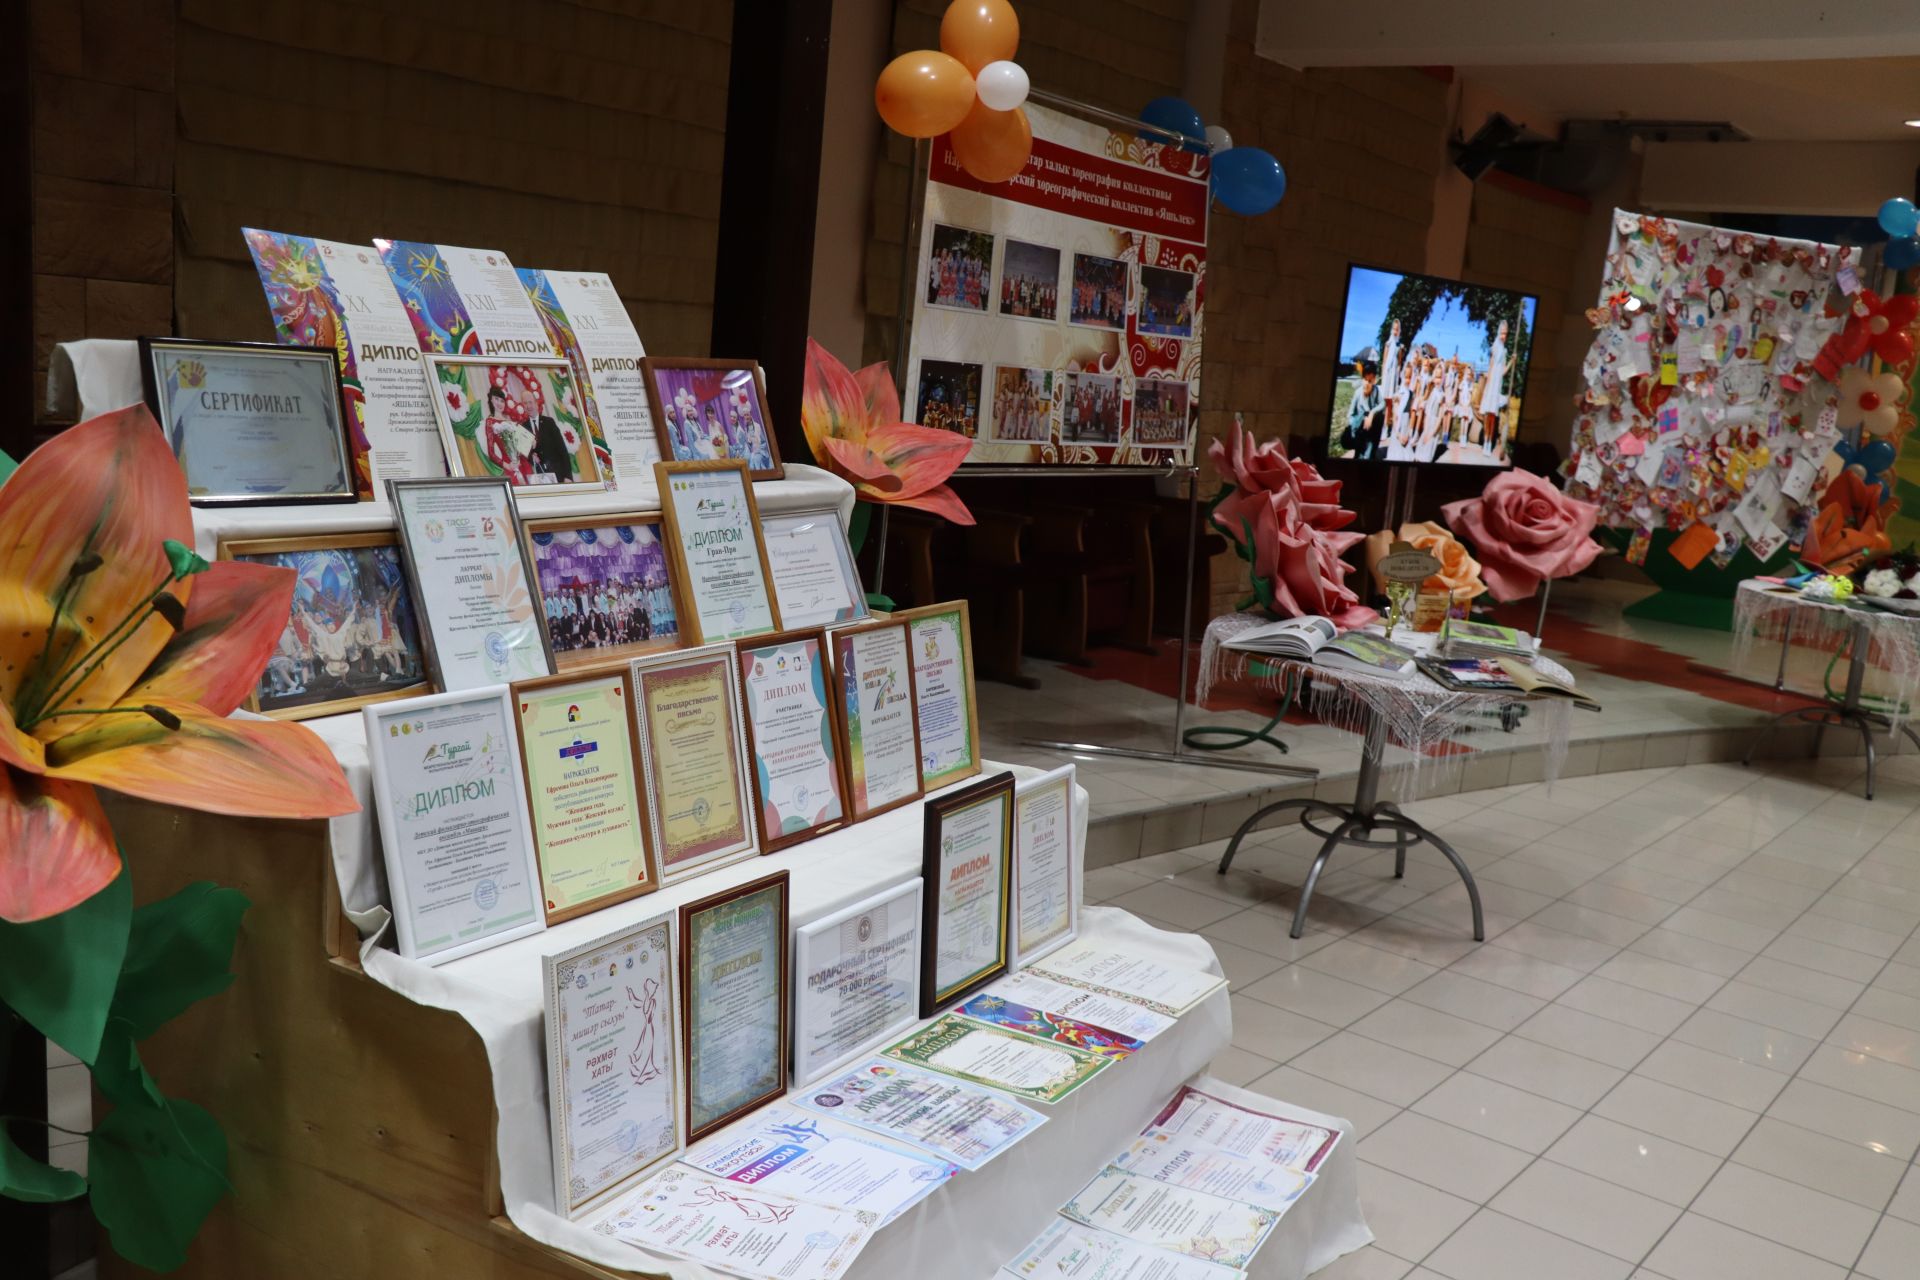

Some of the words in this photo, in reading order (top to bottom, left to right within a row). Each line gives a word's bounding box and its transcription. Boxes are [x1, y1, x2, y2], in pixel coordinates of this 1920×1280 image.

[1045, 158, 1070, 175] халык
[1072, 166, 1120, 189] хореография
[1122, 181, 1172, 200] коллективы
[1009, 173, 1036, 188] рский
[1036, 179, 1110, 206] хореографический
[1111, 198, 1154, 216] коллектив
[361, 344, 420, 362] ДИПЛО
[484, 339, 550, 355] ДИПЛОМ
[200, 391, 302, 414] СЕРТИФИКАТ
[694, 528, 744, 548] ДИПЛОМ
[454, 572, 494, 584] ДИПЛОМЫ
[656, 694, 720, 712] Благодарственное
[764, 682, 806, 702] ДИПЛОМ
[677, 708, 702, 719] письмо
[440, 740, 472, 760] Тургай
[564, 766, 600, 780] НАГРАЖДАЕТСЯ
[416, 778, 495, 816] ДИПЛОМ
[950, 852, 990, 882] ДИПЛОМ
[808, 950, 866, 988] ПОДАРОЧНЫЙ
[868, 929, 916, 961] СЕРТИФИКАТ
[914, 1025, 969, 1058] ДИПЛОМ
[586, 1047, 618, 1070] РӘХМӘТ
[592, 1062, 614, 1080] ХАТЫ
[854, 1078, 915, 1114] ДИПЛОМ
[737, 1148, 798, 1182] ДИПЛОМ
[1154, 1150, 1195, 1182] ДИПЛОМ
[704, 1224, 731, 1248] РӘХМӘТ
[720, 1231, 740, 1248] ХАТЫ
